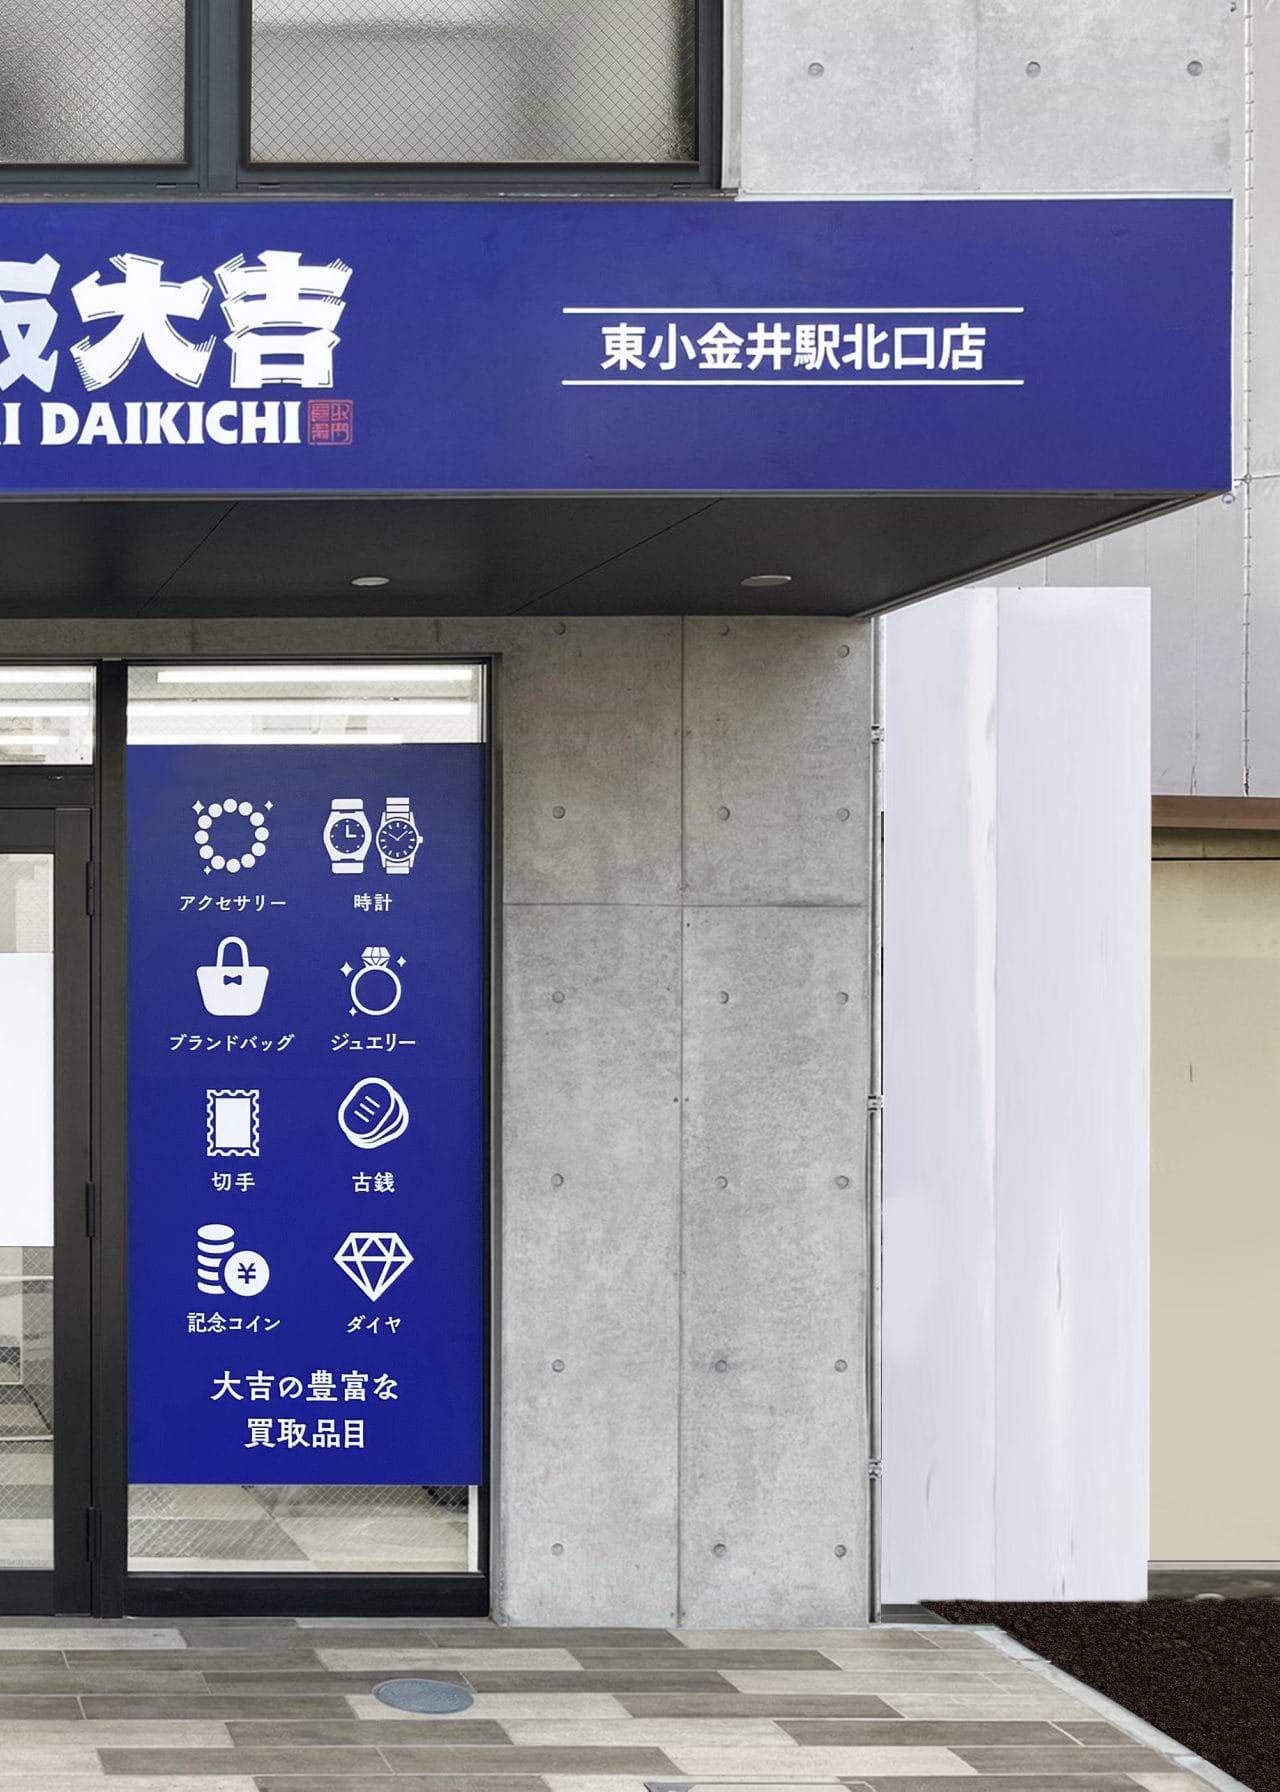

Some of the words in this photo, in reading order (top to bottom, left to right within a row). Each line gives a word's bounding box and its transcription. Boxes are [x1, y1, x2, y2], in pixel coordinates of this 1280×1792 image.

[600, 322, 987, 371] 東小金井駅北口店
[40, 401, 301, 446] DAIKICHI
[179, 894, 286, 912] アクセサリー
[353, 893, 393, 912] 時計
[170, 1033, 296, 1052] ブランドバッグ
[331, 1033, 416, 1052] ジュエリー
[211, 1172, 256, 1192] 切手
[351, 1172, 395, 1193] 古銭
[187, 1312, 281, 1333] 記念コイン
[347, 1314, 401, 1334] ダイヤ
[210, 1369, 399, 1402] 大吉の豊富な
[244, 1418, 364, 1449] 買取品目
